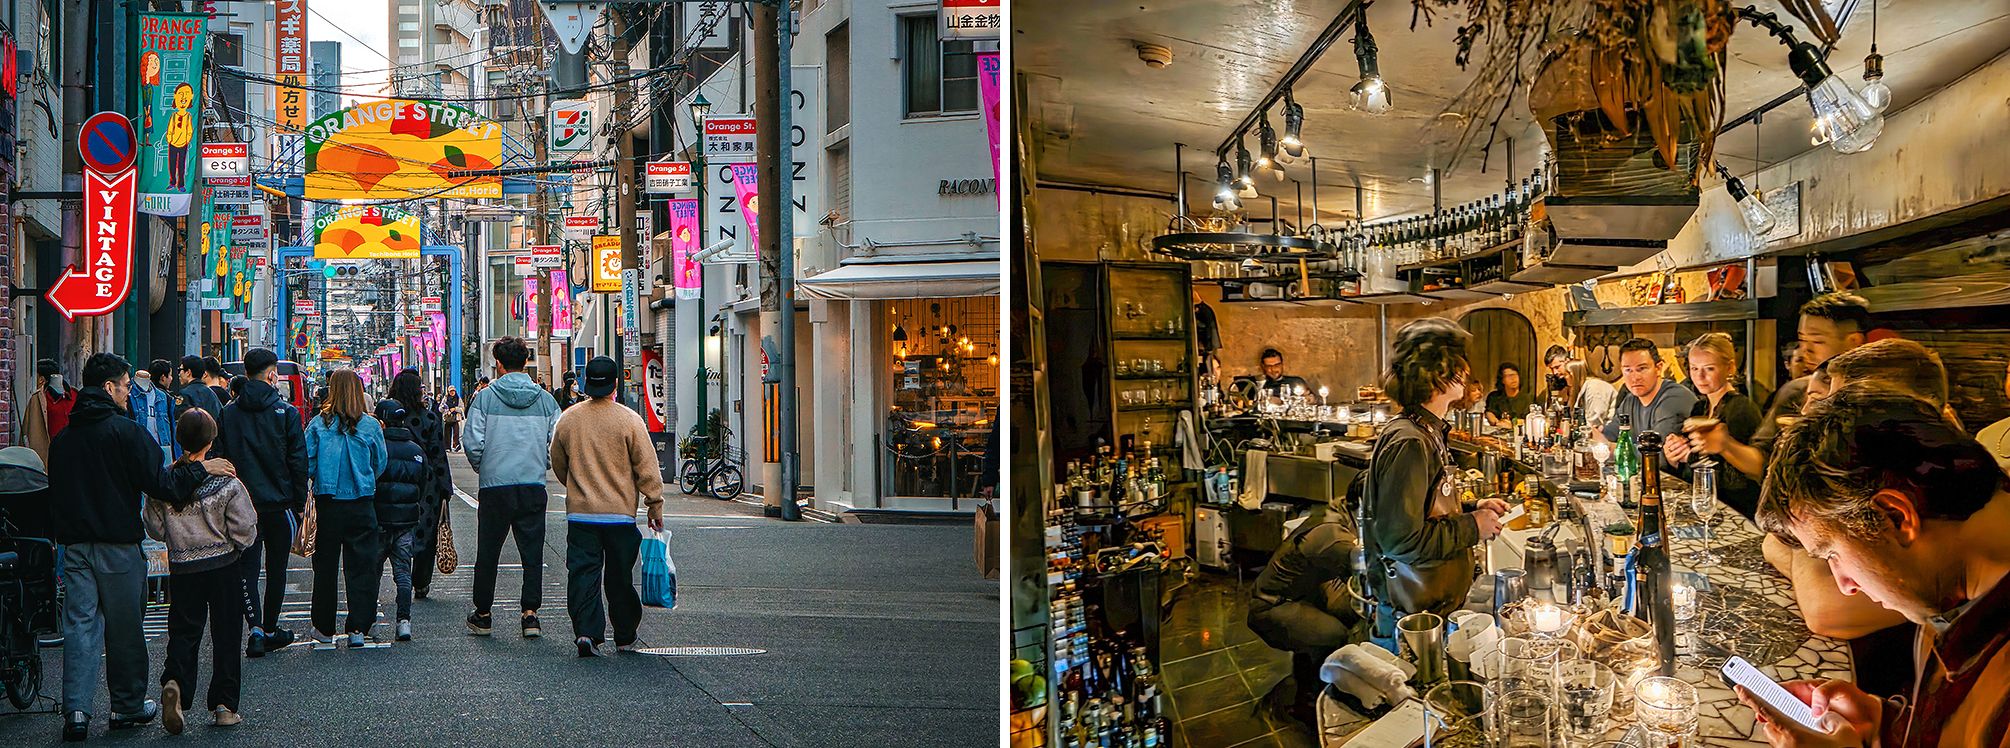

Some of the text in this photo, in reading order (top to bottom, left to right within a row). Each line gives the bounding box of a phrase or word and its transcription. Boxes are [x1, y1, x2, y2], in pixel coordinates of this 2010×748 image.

[142, 16, 202, 34] ORANGE
[947, 14, 1000, 28] 山金金物
[141, 34, 195, 51] STREET
[280, 0, 301, 72] スギ薬局
[283, 75, 300, 132] 処方せん
[308, 102, 498, 144] ORANGE STREET
[707, 122, 755, 132] Orange St.
[202, 146, 245, 155] Orange St.
[708, 142, 754, 152] 大和家具
[211, 161, 237, 173] esq
[649, 165, 677, 173] Orange
[214, 190, 249, 198] 士硝子販売
[316, 207, 418, 229] ORANGE STREET
[95, 191, 119, 297] VINTAGE
[648, 364, 664, 416] たばこ
